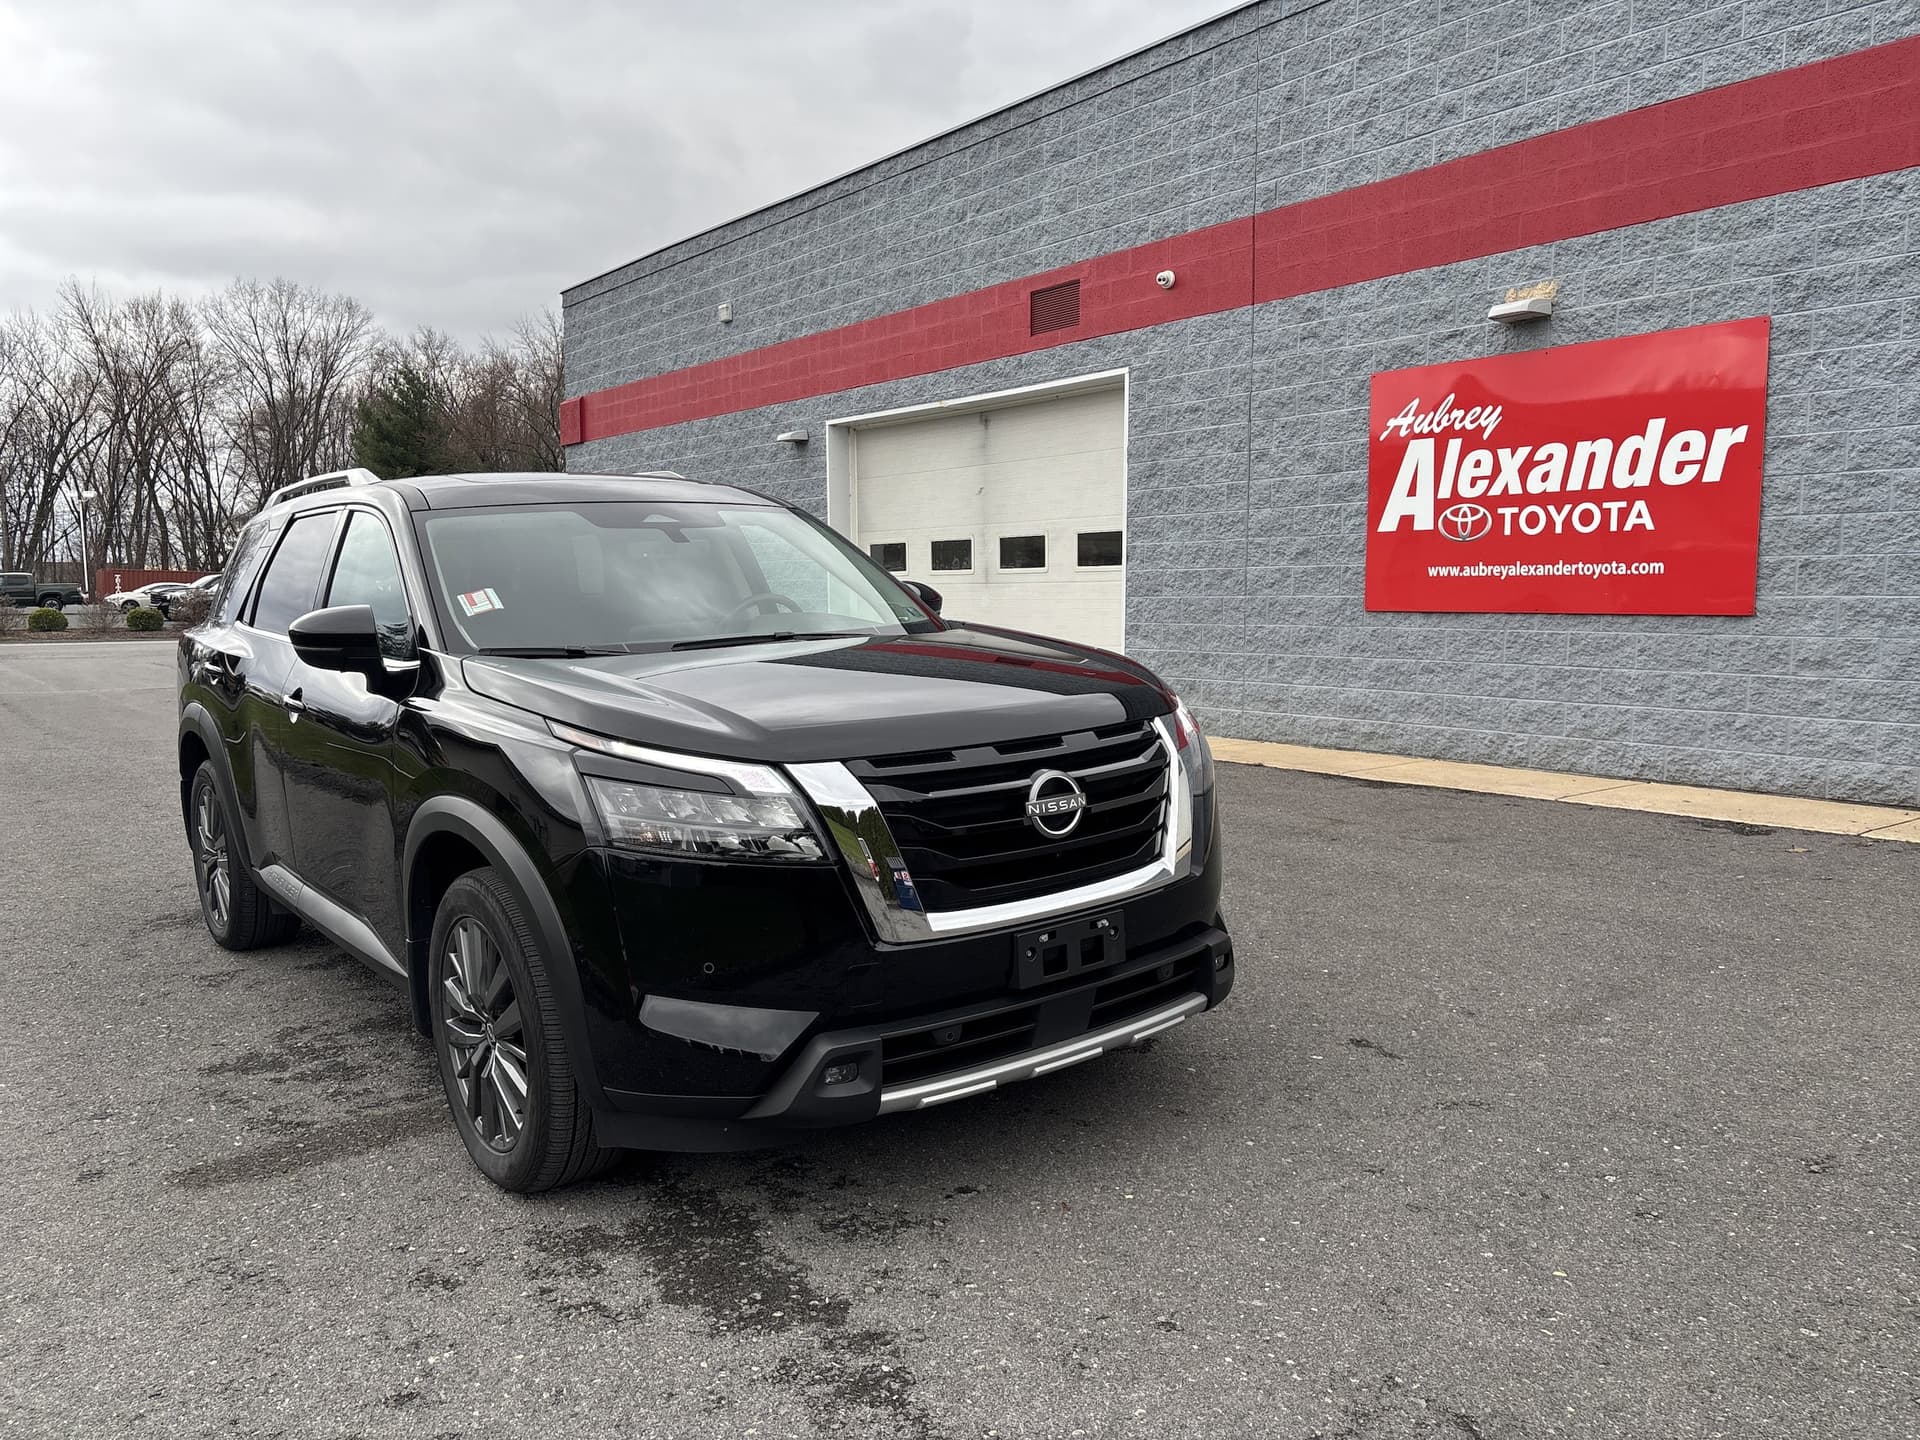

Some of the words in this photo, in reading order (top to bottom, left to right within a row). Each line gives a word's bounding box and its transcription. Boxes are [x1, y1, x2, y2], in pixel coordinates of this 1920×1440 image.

[1379, 393, 1503, 440] Aubrey
[1376, 417, 1749, 533] Alexander
[1497, 500, 1655, 536] TOYOTA
[1427, 559, 1665, 580] www.aubreyalexandertoyota.com
[1028, 797, 1086, 815] NISSAN
